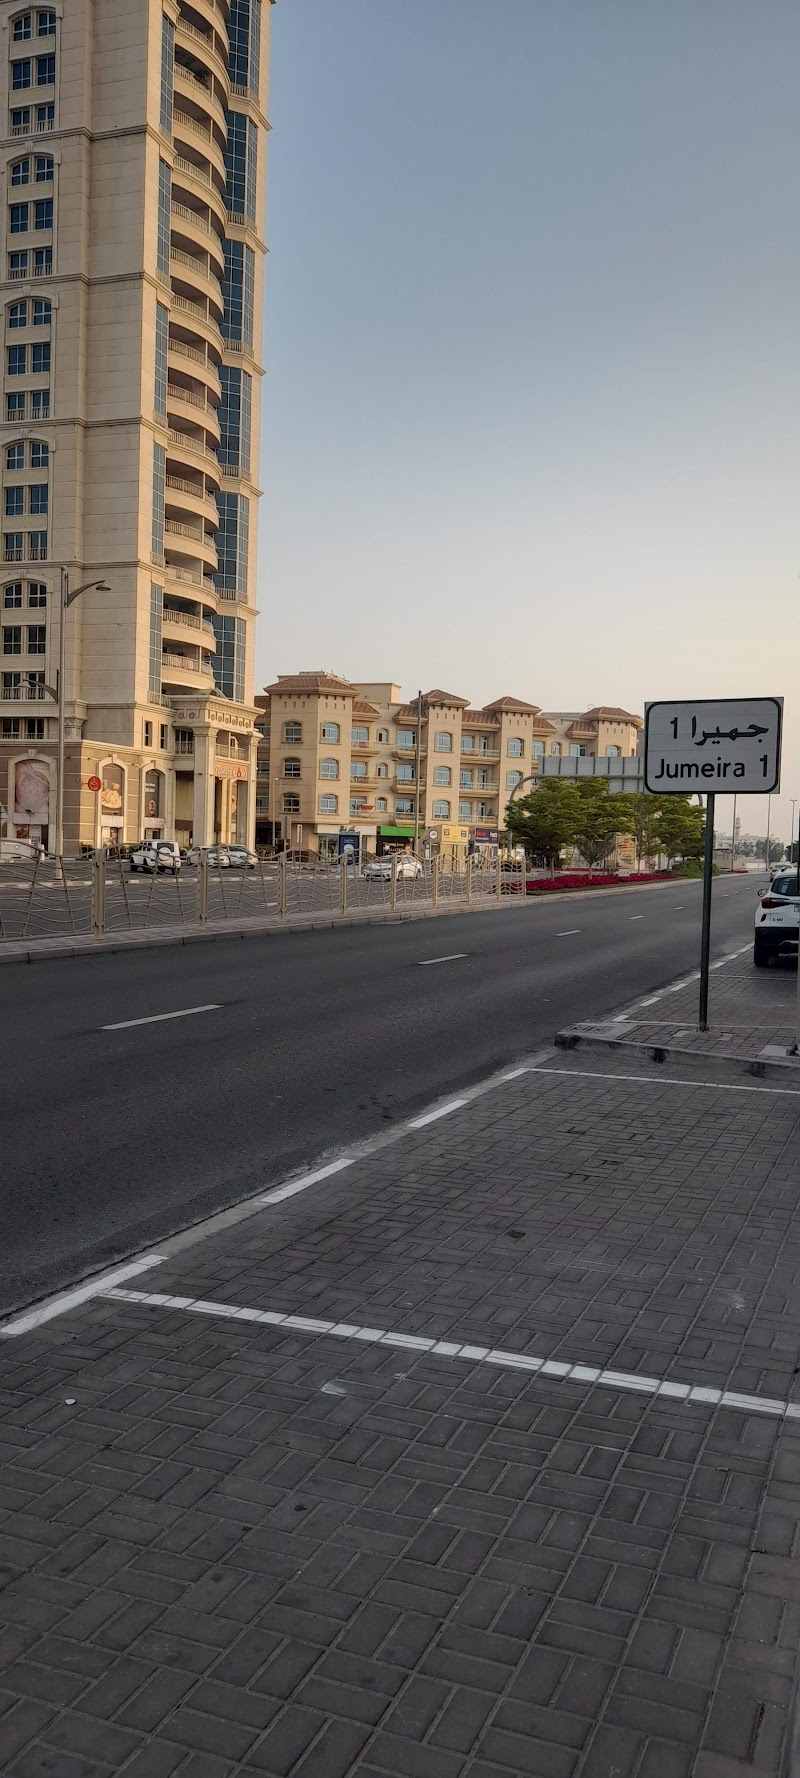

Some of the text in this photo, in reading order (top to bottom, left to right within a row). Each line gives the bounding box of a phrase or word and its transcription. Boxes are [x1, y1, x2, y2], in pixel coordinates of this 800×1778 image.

[670, 715, 770, 746] جميرا 1
[654, 754, 768, 779] Jumeira 1
